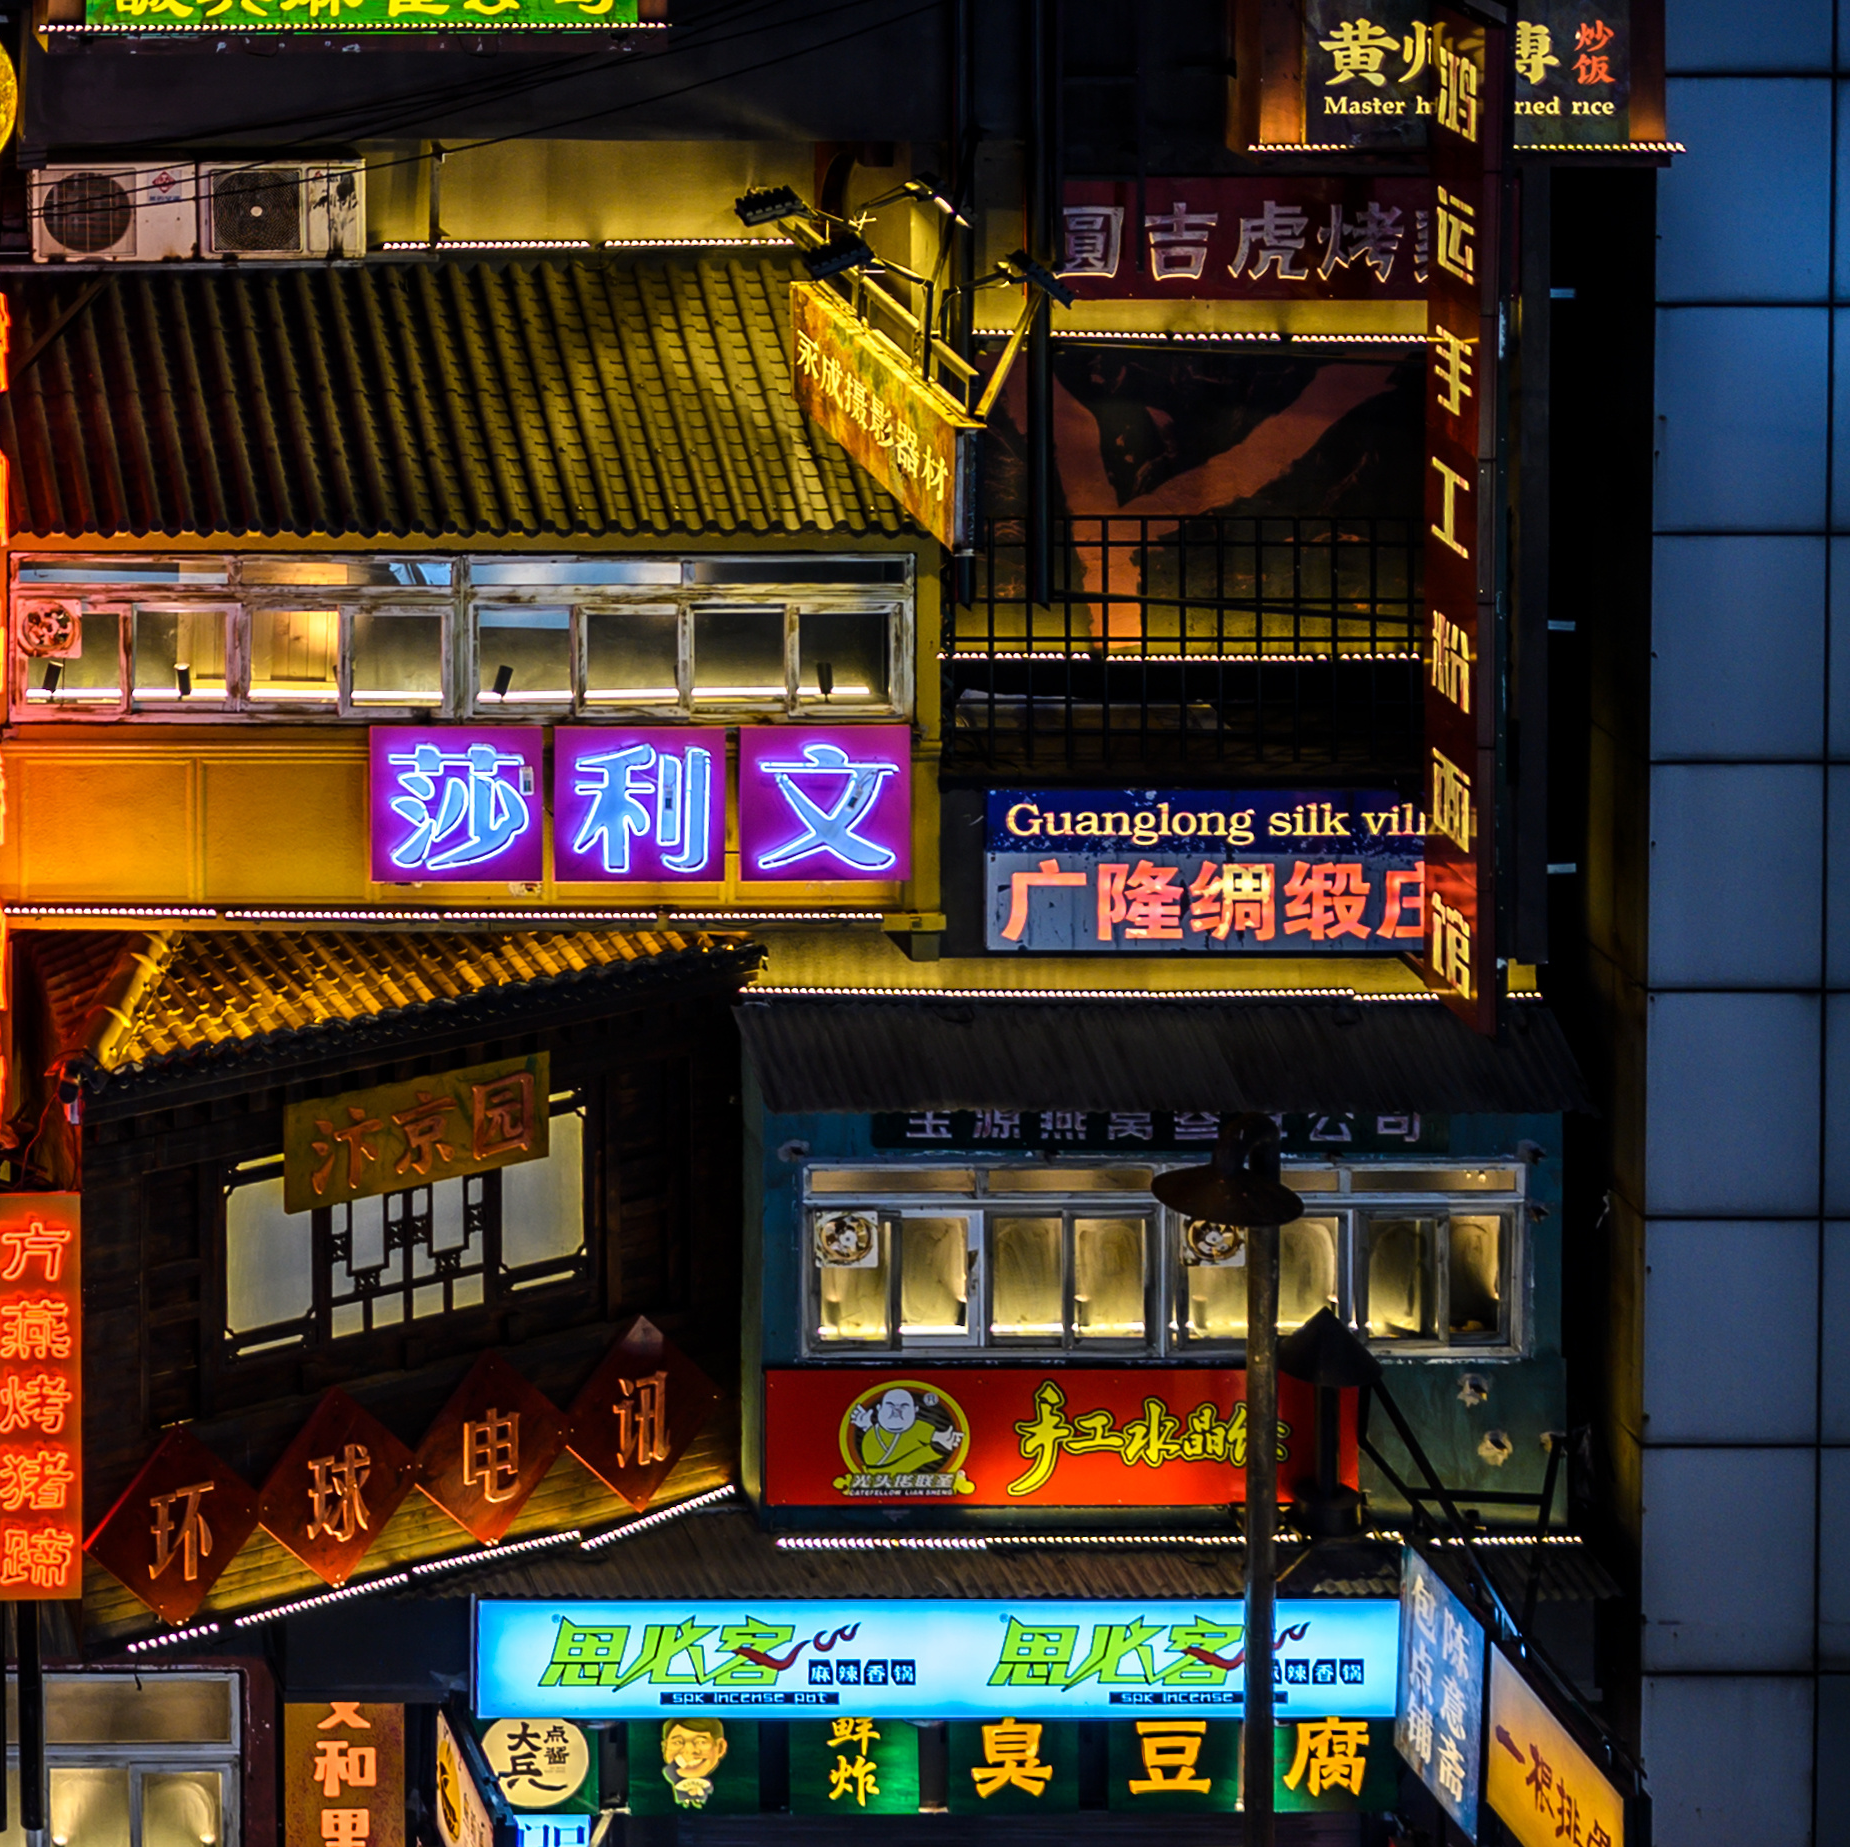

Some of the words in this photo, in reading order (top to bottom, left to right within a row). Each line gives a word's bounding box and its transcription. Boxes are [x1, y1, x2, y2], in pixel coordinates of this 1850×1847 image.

[1575, 21, 1617, 85] 炒饭
[1324, 96, 1406, 116] Master
[1571, 97, 1615, 116] rice
[797, 329, 949, 503] 永成摄影器材
[389, 743, 899, 873] 莎利文
[1005, 803, 1256, 846] Guanglong
[1268, 803, 1351, 837] silk
[310, 1070, 536, 1196] 汴京园
[148, 1369, 673, 1582] 环球电讯
[808, 1659, 917, 1687] 麻辣香锅
[1273, 1658, 1364, 1685] 辣香锅
[499, 1719, 568, 1789] 大兵
[829, 1717, 881, 1806] 鲜炸
[970, 1717, 1371, 1797] 臭豆腐
